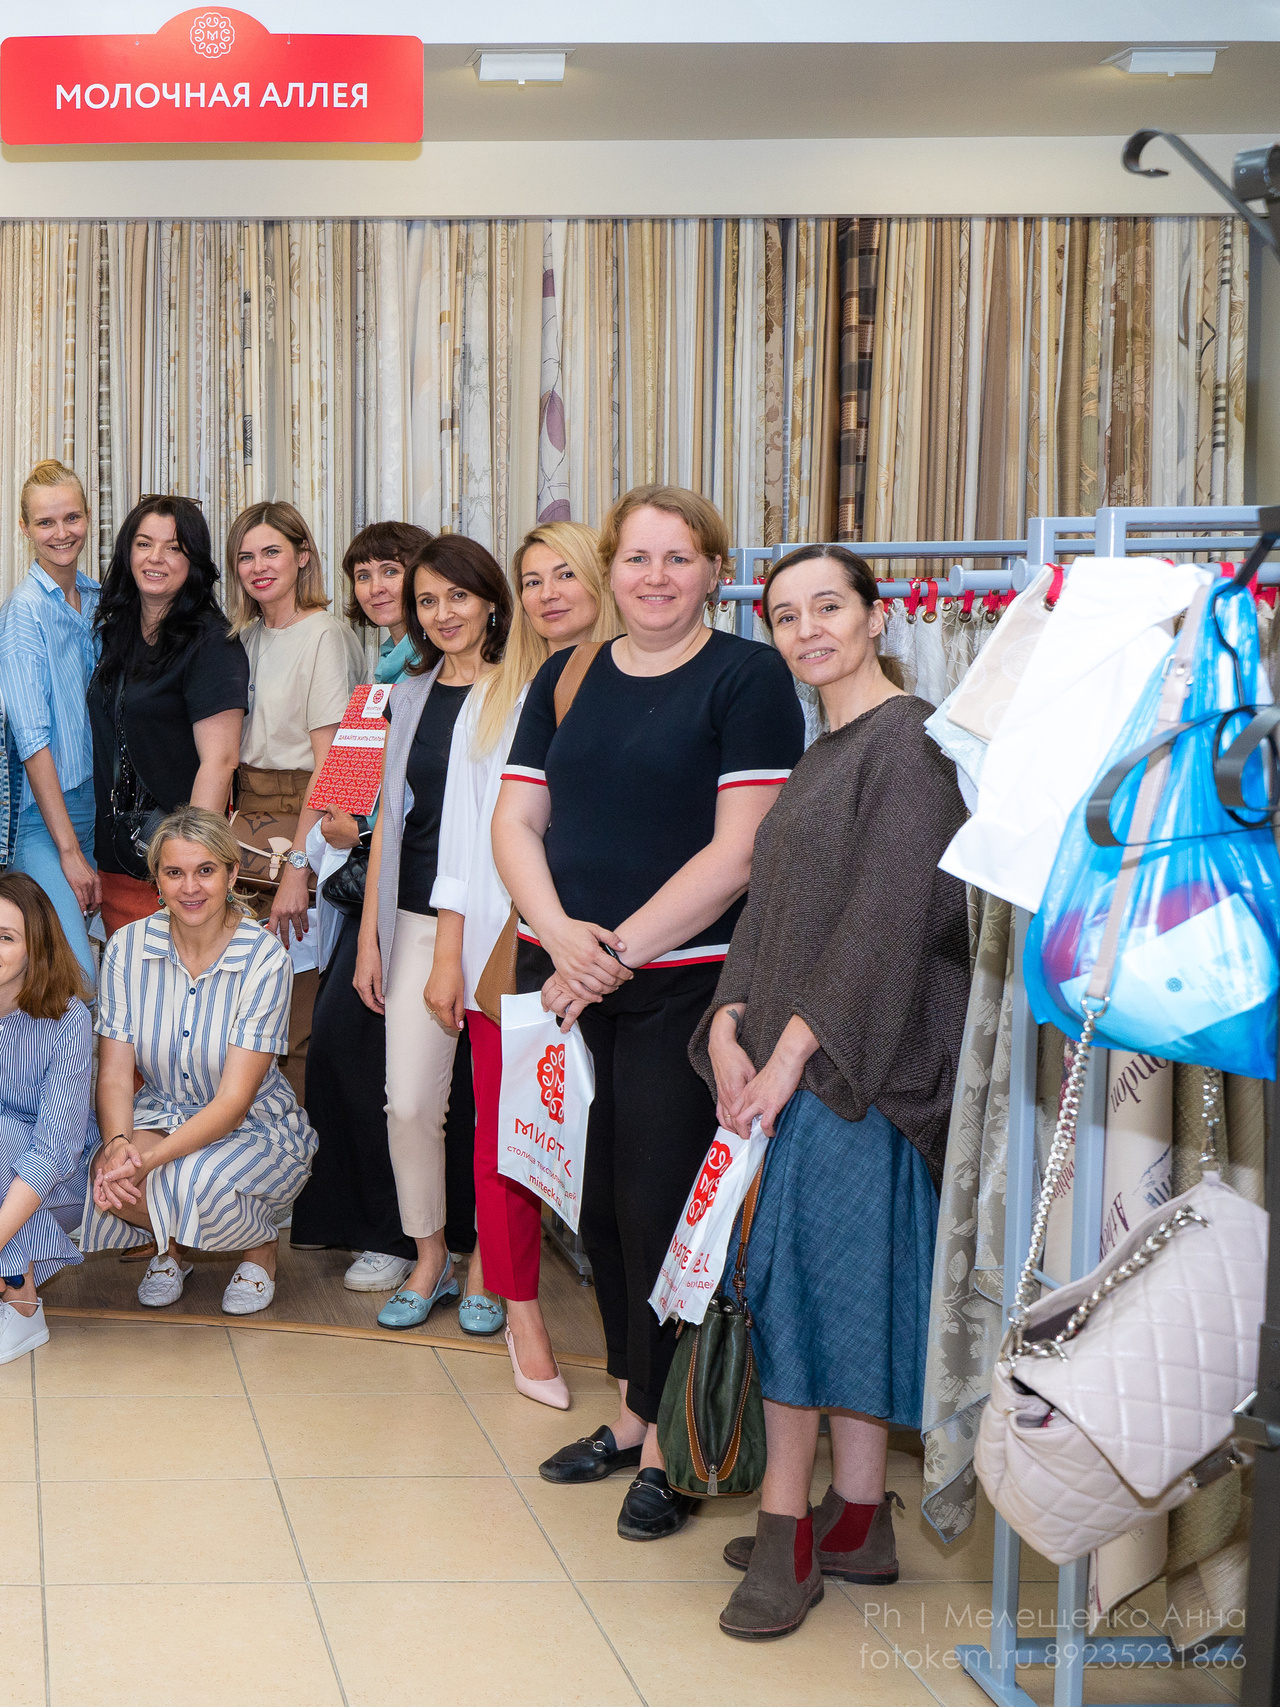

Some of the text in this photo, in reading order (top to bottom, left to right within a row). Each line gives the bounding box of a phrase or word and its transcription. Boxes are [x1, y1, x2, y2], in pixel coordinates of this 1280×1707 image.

[56, 82, 368, 110] МОЛОЧНАЯ АЛЛЕЯ
[528, 1174, 563, 1207] mirteck.ru
[564, 1190, 577, 1201] дей
